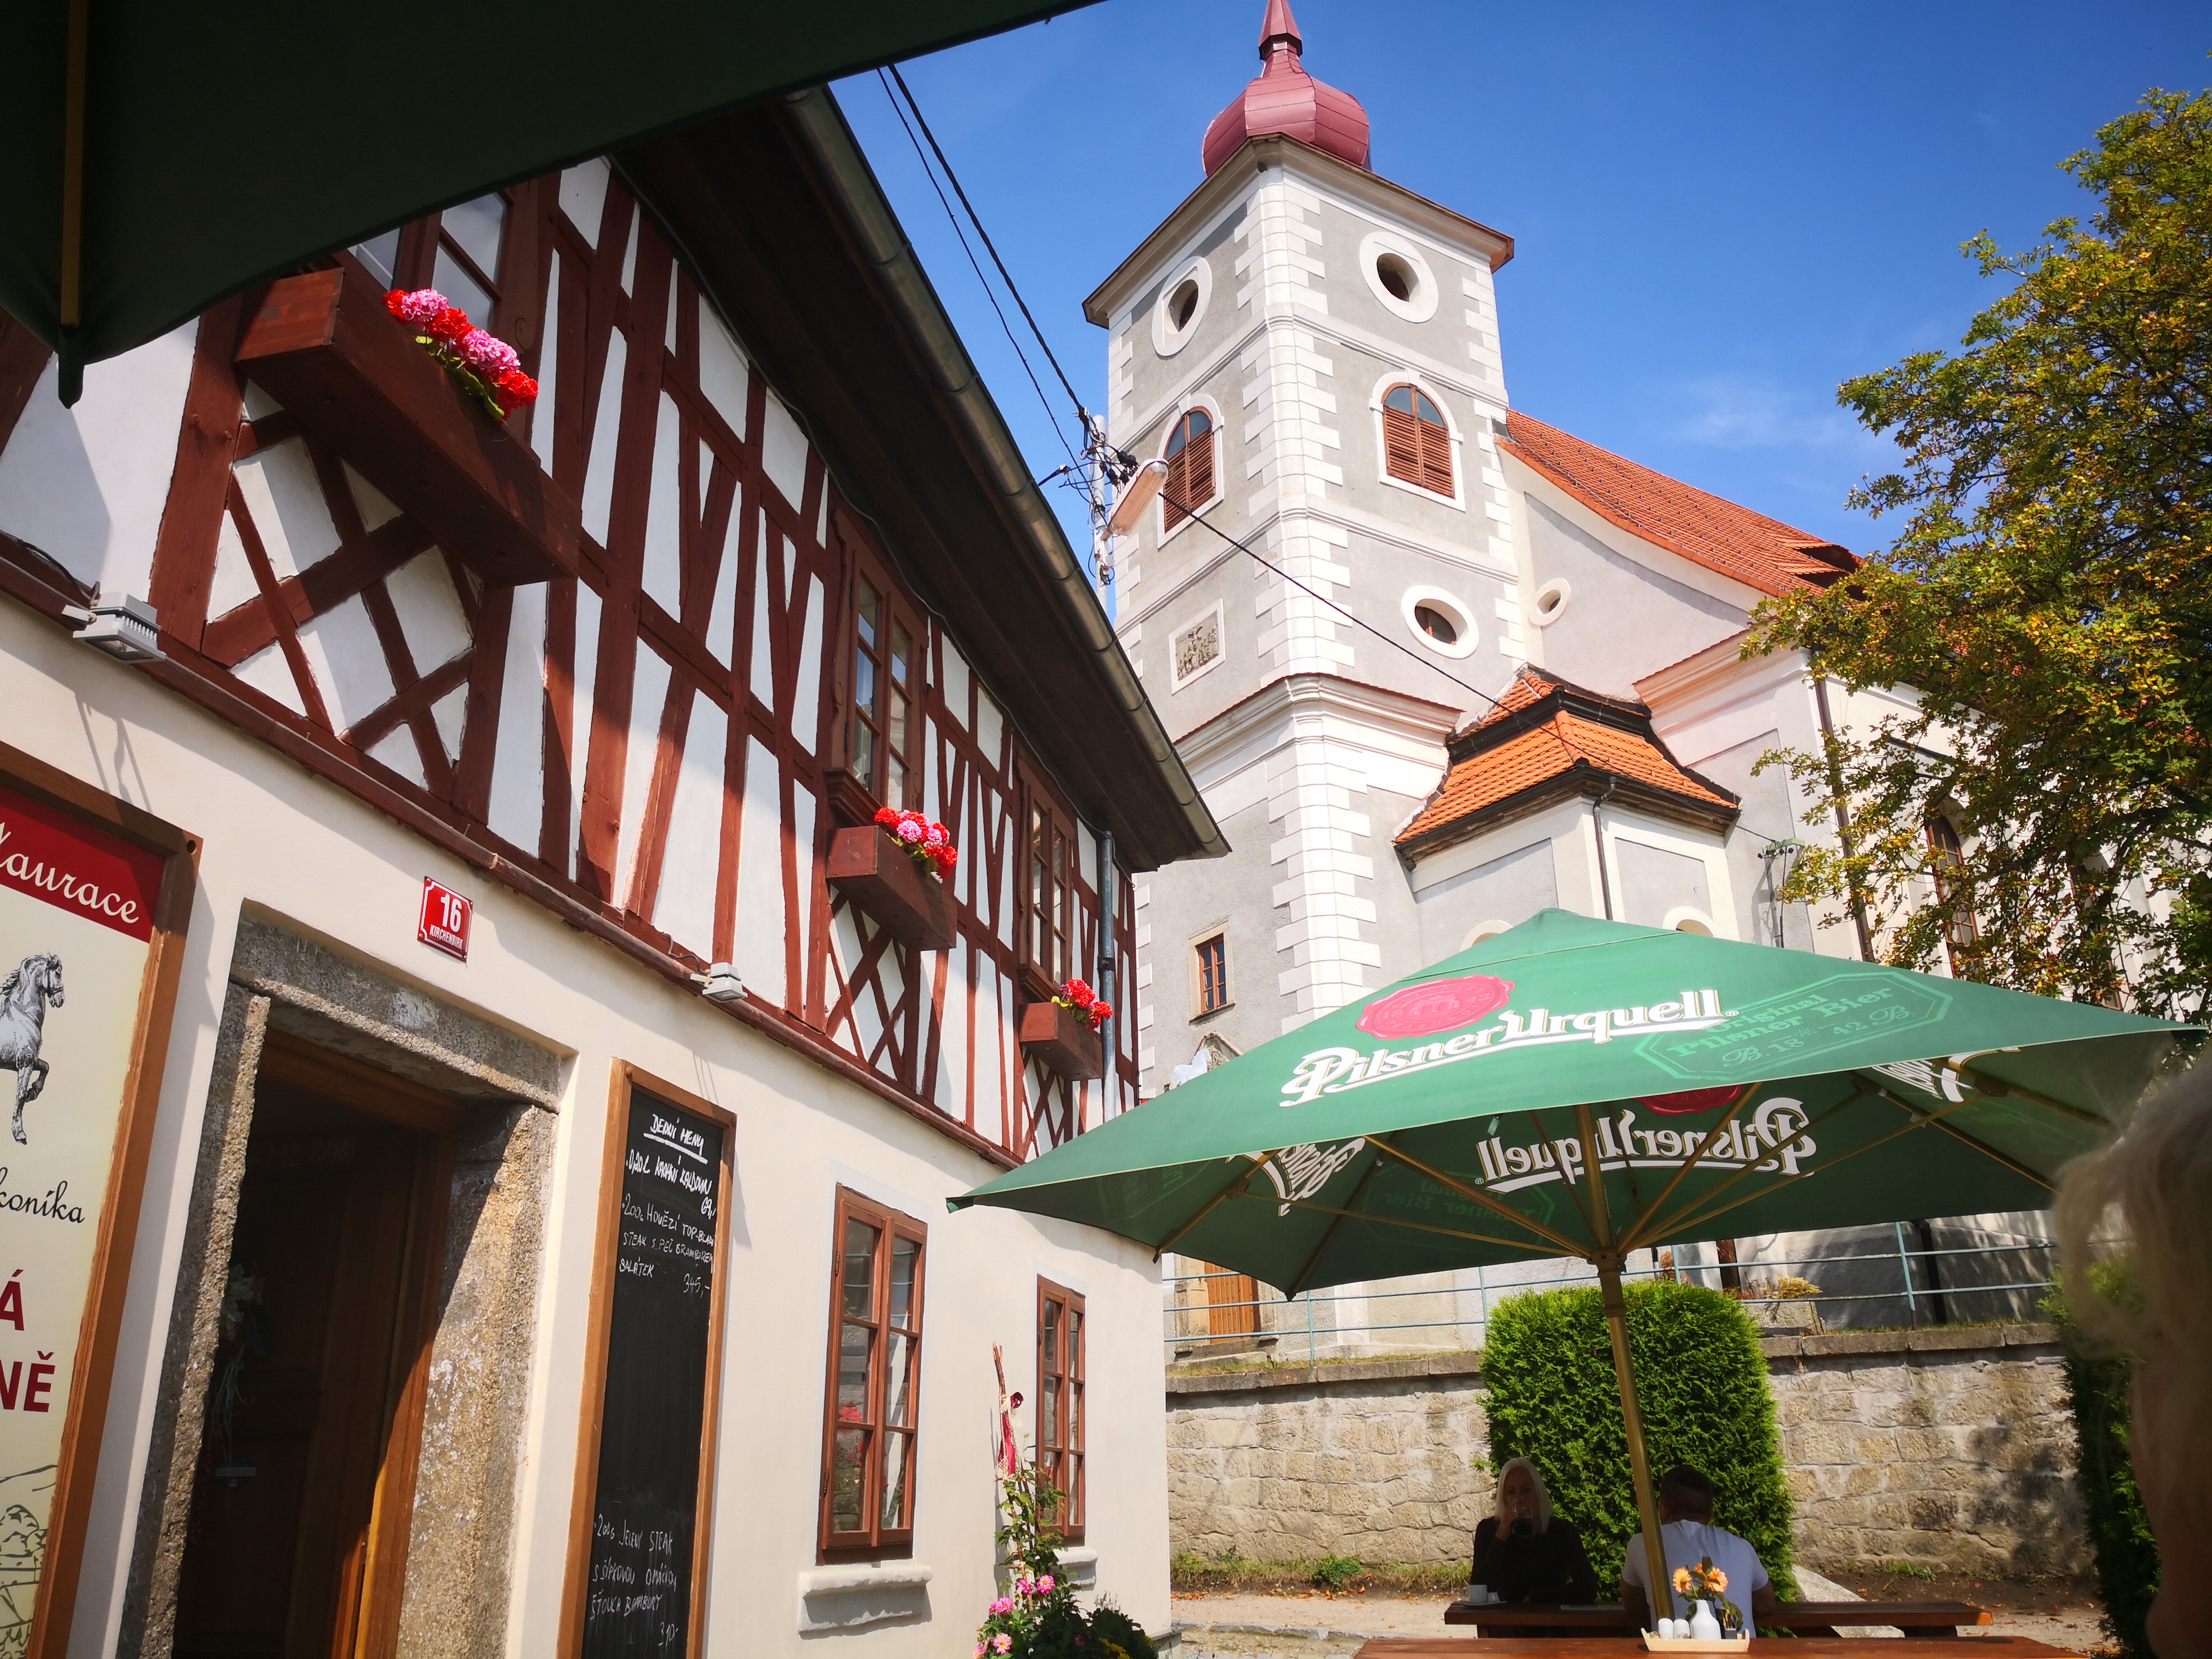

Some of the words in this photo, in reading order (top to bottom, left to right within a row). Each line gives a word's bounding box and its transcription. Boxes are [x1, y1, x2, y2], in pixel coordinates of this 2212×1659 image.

[0, 822, 139, 923] aurace
[440, 892, 462, 933] 16
[429, 924, 463, 949] KIRCHENBIRK
[1666, 1016, 1802, 1058] Pilsner
[1810, 987, 1894, 1017] Bier
[1705, 994, 1829, 1033] Original
[1278, 1027, 1503, 1108] Pilsner
[1498, 988, 1725, 1045] Urquell
[647, 1202, 681, 1231] HOVĚZÍ
[623, 1231, 647, 1246] STEAK
[619, 1256, 655, 1278] SALÁTEK
[648, 1531, 673, 1555] STEAK
